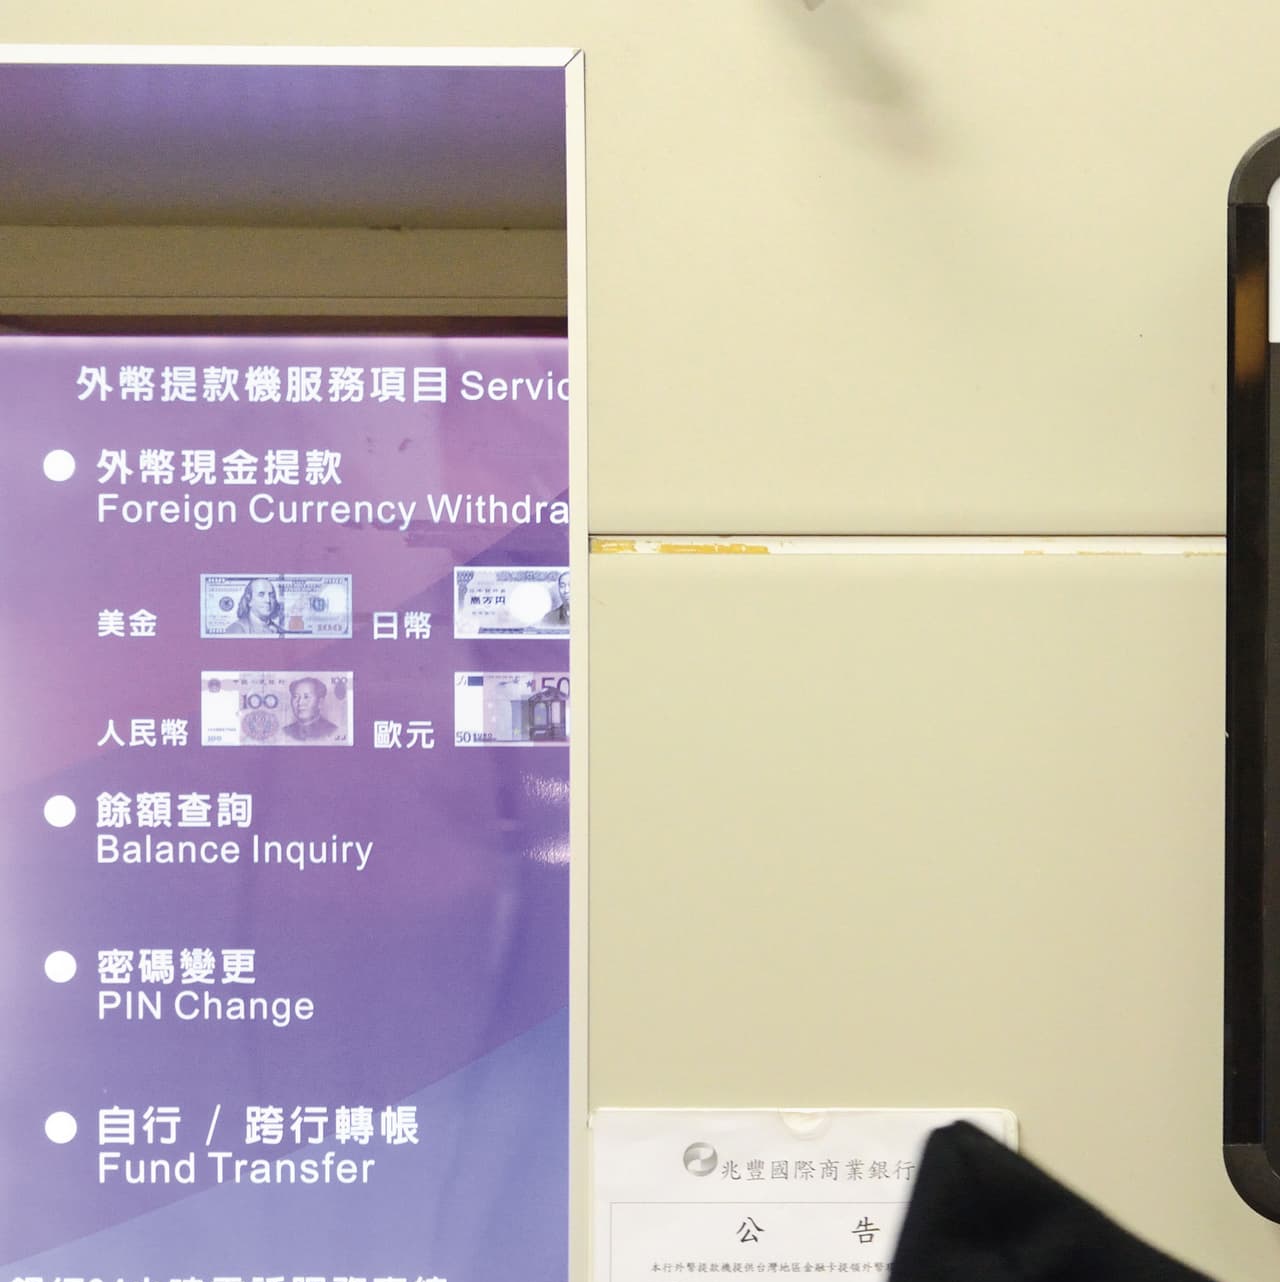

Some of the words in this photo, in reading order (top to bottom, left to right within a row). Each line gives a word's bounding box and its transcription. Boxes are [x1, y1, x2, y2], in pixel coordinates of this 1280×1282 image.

[76, 366, 447, 402] 外幣提款機服務項目
[97, 450, 342, 485] 外幣現金提款
[97, 494, 237, 530] Foreign
[248, 494, 416, 531] Currency
[97, 608, 157, 638] 美金
[373, 611, 432, 640] 日幣
[242, 694, 279, 709] 100
[97, 719, 189, 747] 人民幣
[373, 720, 435, 749] 歐元
[96, 793, 253, 828] 餘額查詢
[97, 835, 241, 864] Balance
[253, 835, 373, 870] Inquiry
[97, 949, 257, 984] 密碼變更
[98, 992, 162, 1019] PIN
[174, 991, 314, 1027] Change
[98, 1107, 181, 1145] 自行
[246, 1106, 419, 1145] 跨行轉帳
[98, 1153, 195, 1184] Fund
[208, 1153, 375, 1184] Transfer
[721, 1159, 915, 1181] 兆豐國際商業銀行
[736, 1216, 880, 1244] 公告
